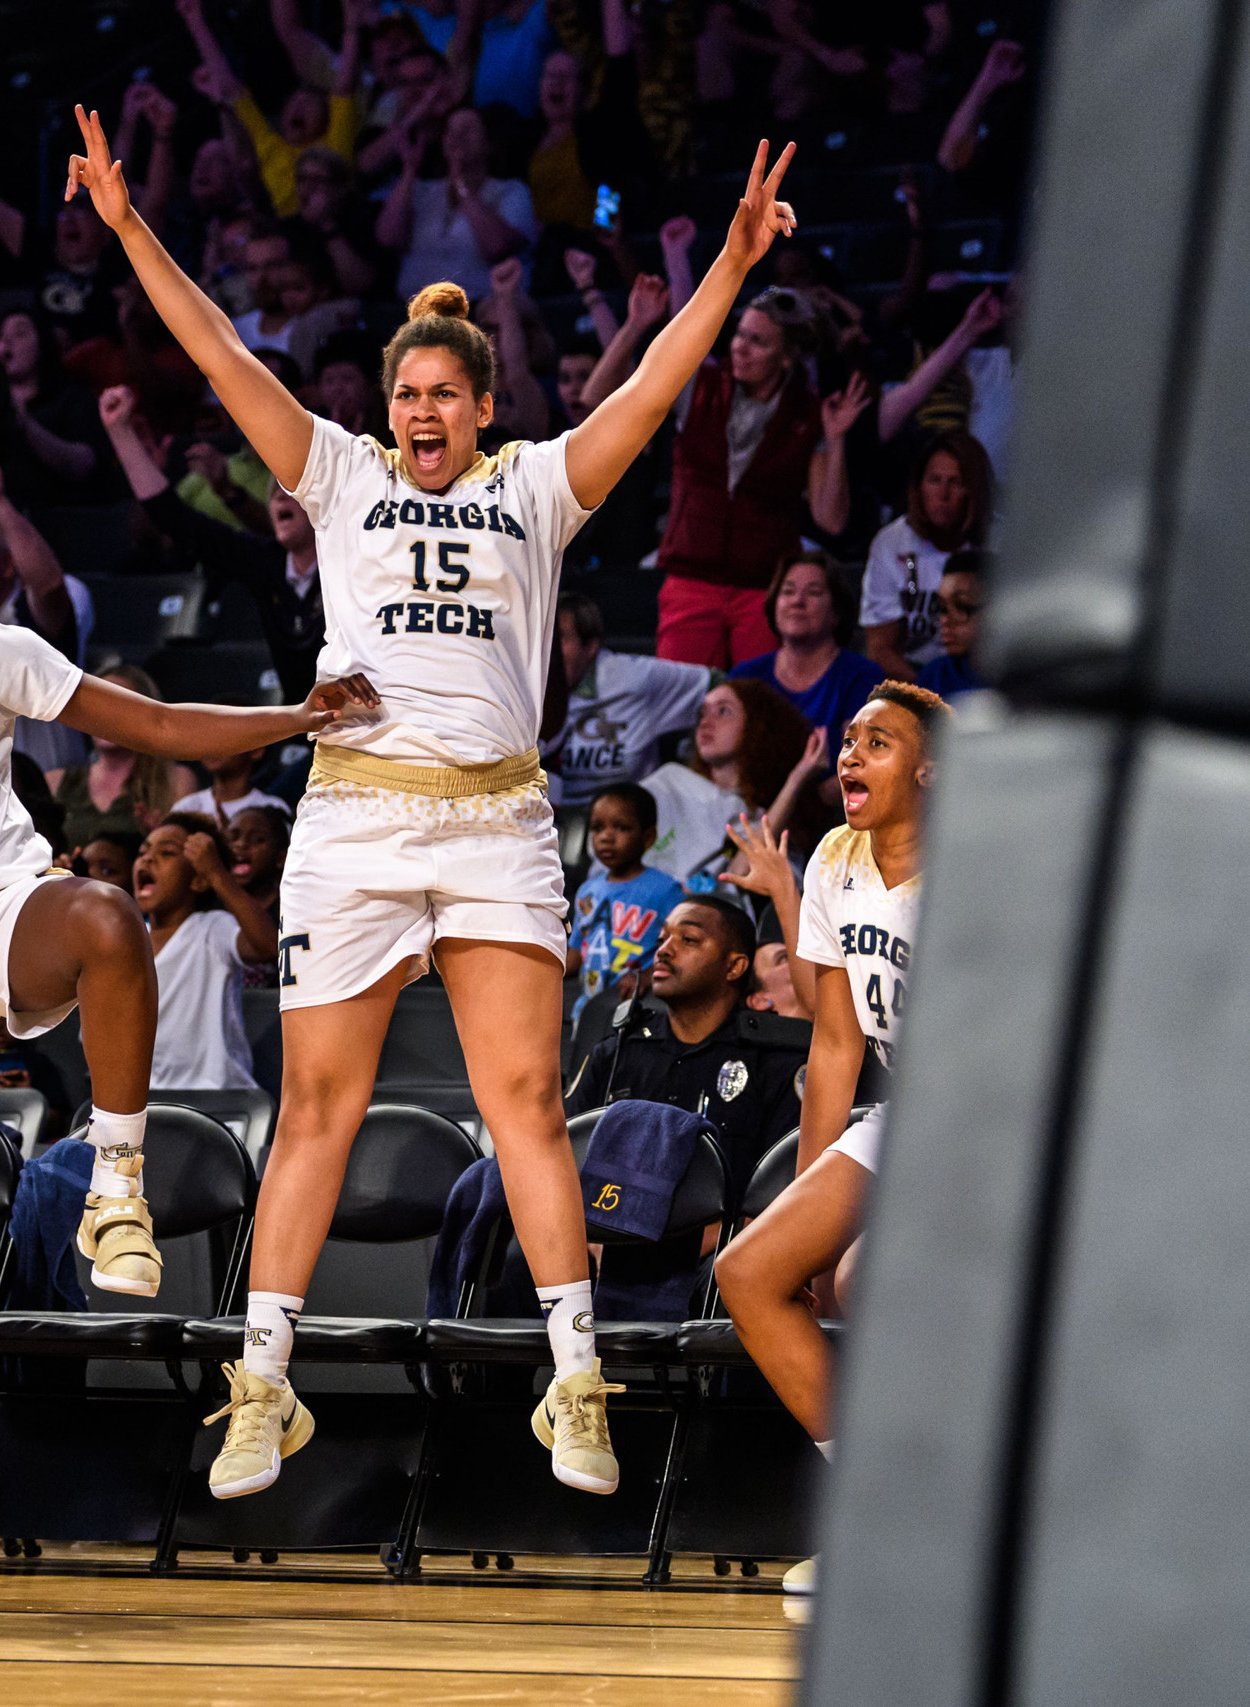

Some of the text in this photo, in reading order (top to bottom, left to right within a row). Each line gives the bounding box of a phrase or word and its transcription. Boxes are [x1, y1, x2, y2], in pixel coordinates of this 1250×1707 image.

[363, 499, 526, 541] GEORGIA
[409, 540, 471, 593] 15
[376, 603, 496, 640] TECH
[278, 933, 311, 989] T
[591, 1183, 622, 1211] 15
